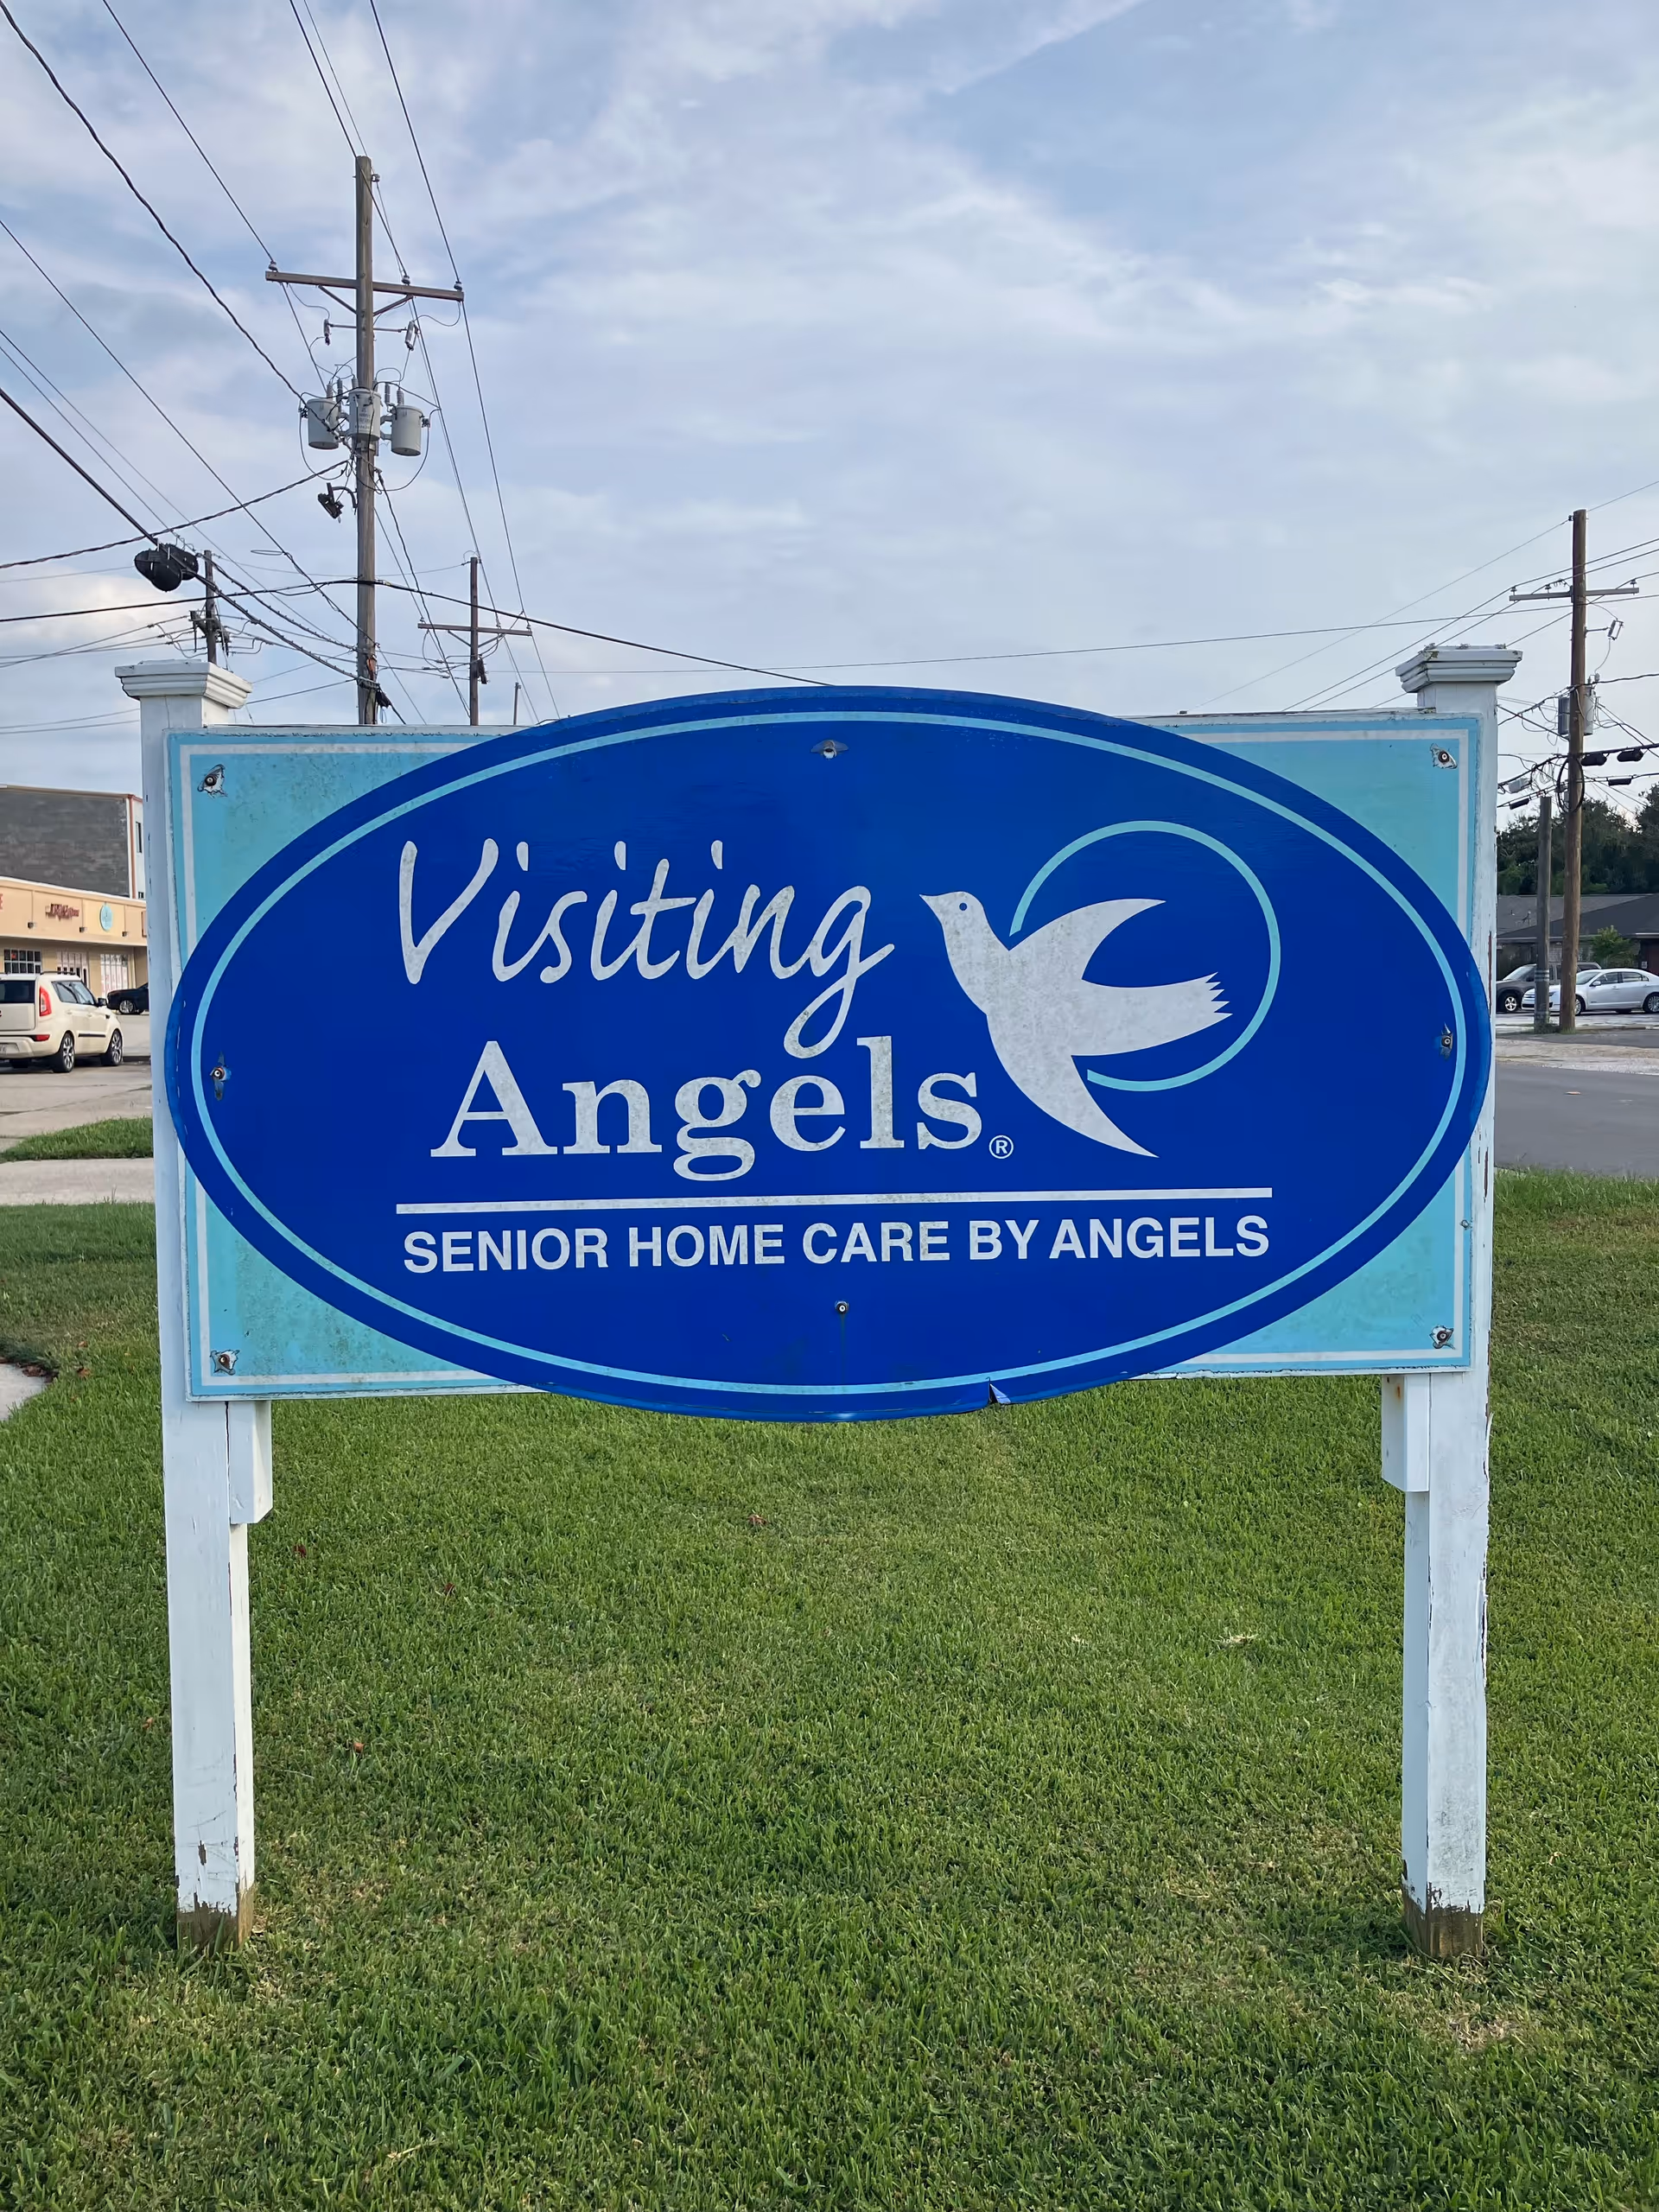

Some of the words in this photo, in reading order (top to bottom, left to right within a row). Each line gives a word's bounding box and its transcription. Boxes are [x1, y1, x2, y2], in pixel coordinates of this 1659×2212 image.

[398, 838, 895, 1059] Visiting
[430, 1035, 982, 1181] Angels
[404, 1228, 609, 1274] SENIOR
[628, 1223, 785, 1267] HOME
[803, 1221, 950, 1264] CARE
[969, 1219, 1039, 1261] BY
[1049, 1215, 1269, 1260] ANGELS
